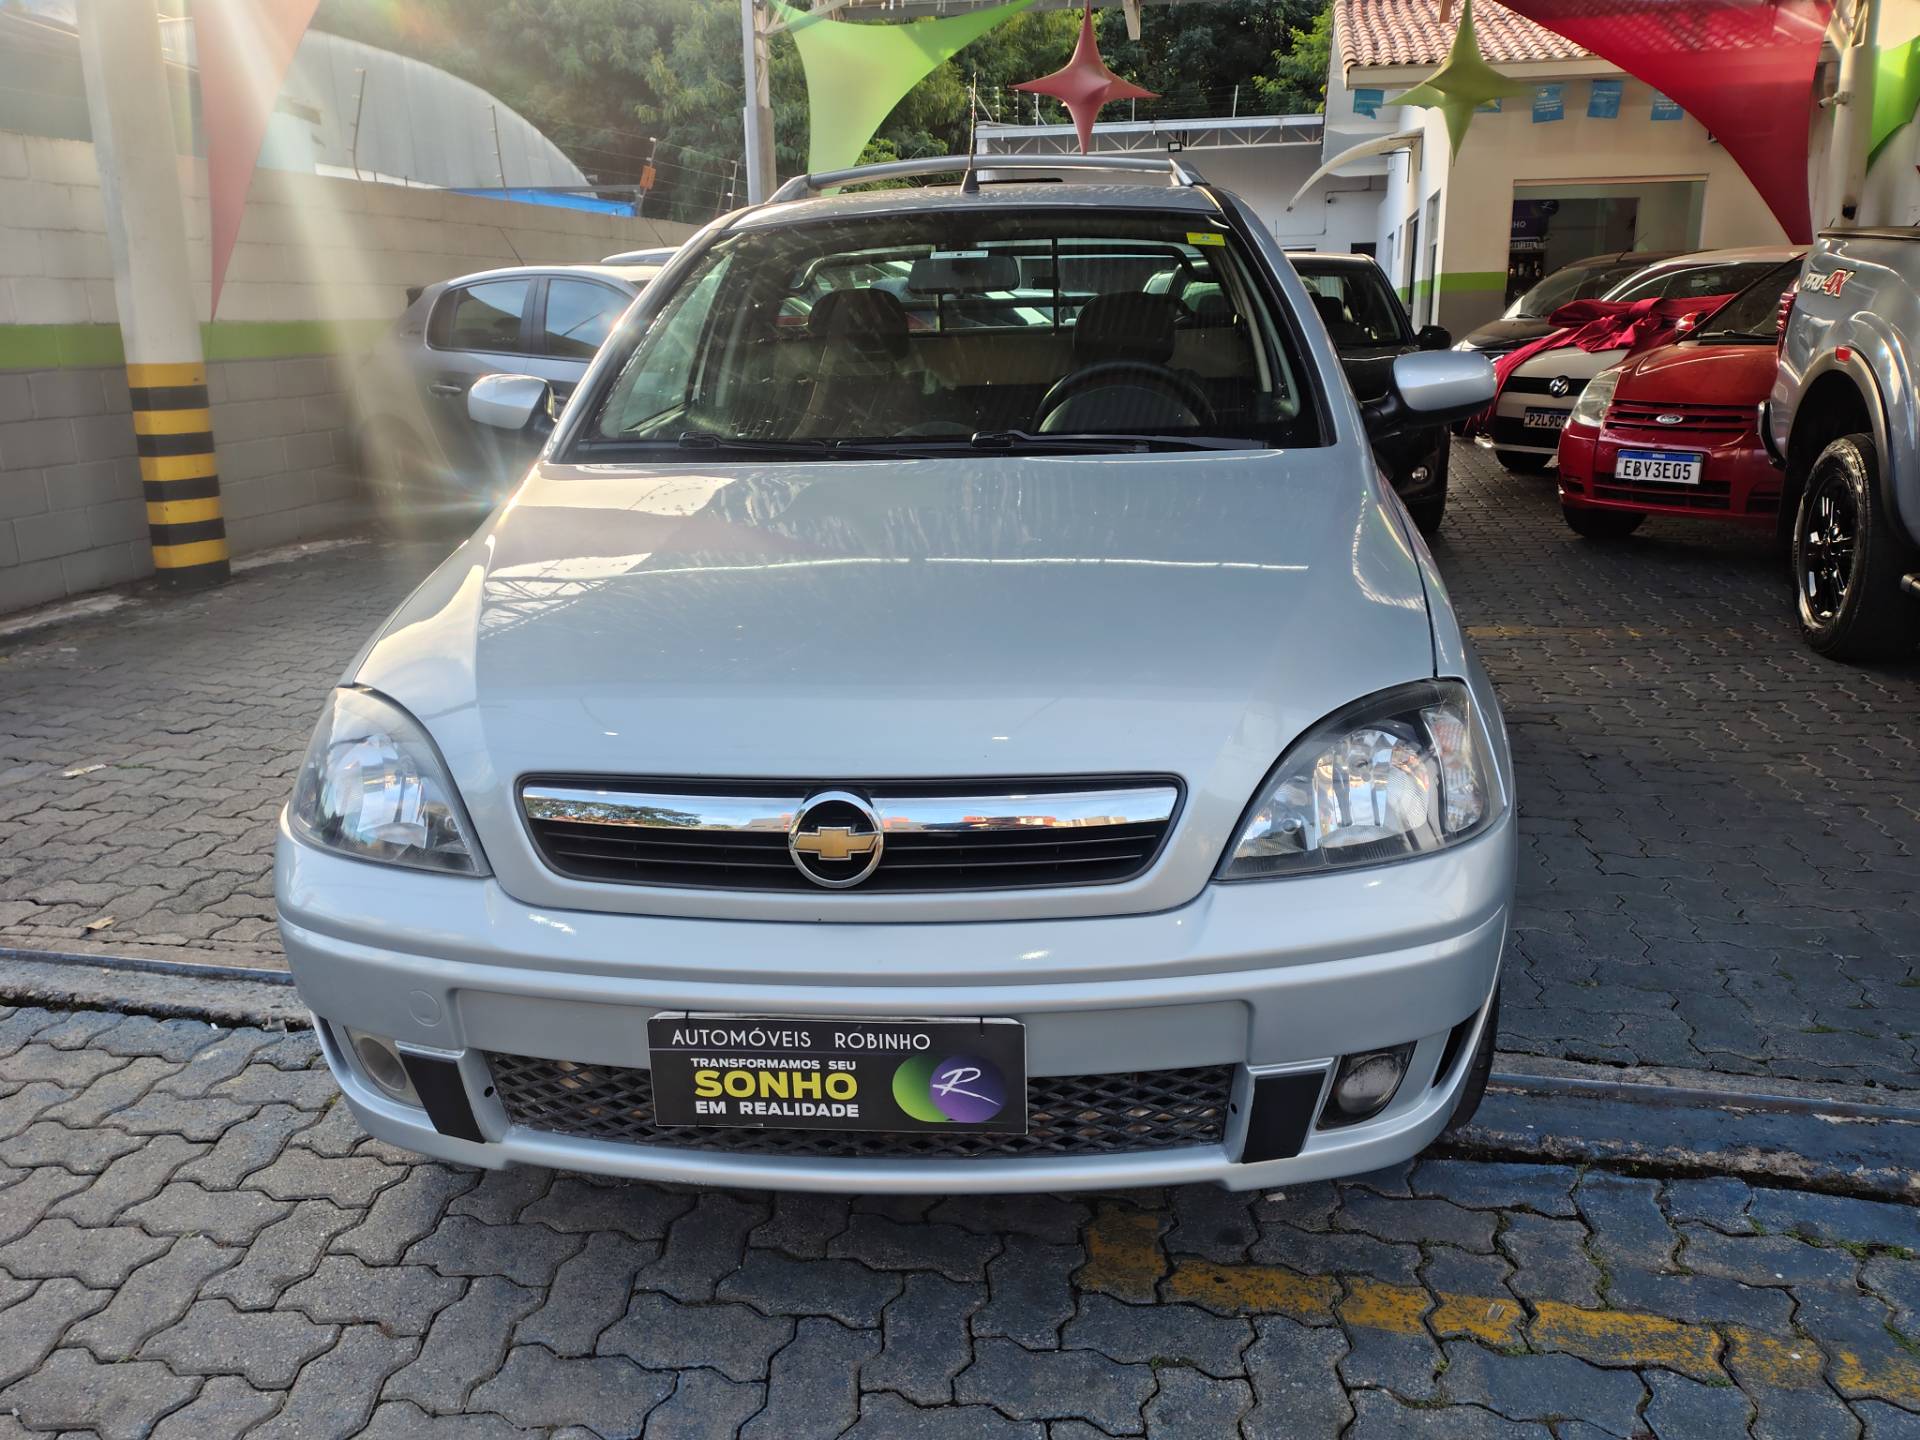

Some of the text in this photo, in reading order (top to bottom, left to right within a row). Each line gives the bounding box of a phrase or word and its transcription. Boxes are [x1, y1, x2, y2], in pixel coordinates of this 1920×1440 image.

[1623, 460, 1692, 480] EBY3E05
[671, 1026, 931, 1051] AUTOMÓVEIS ROBINHO
[690, 1057, 857, 1071] TRANSFORMAMOS SEU
[694, 1070, 858, 1101] SONHO
[695, 1100, 860, 1118] EM REALIDADE
